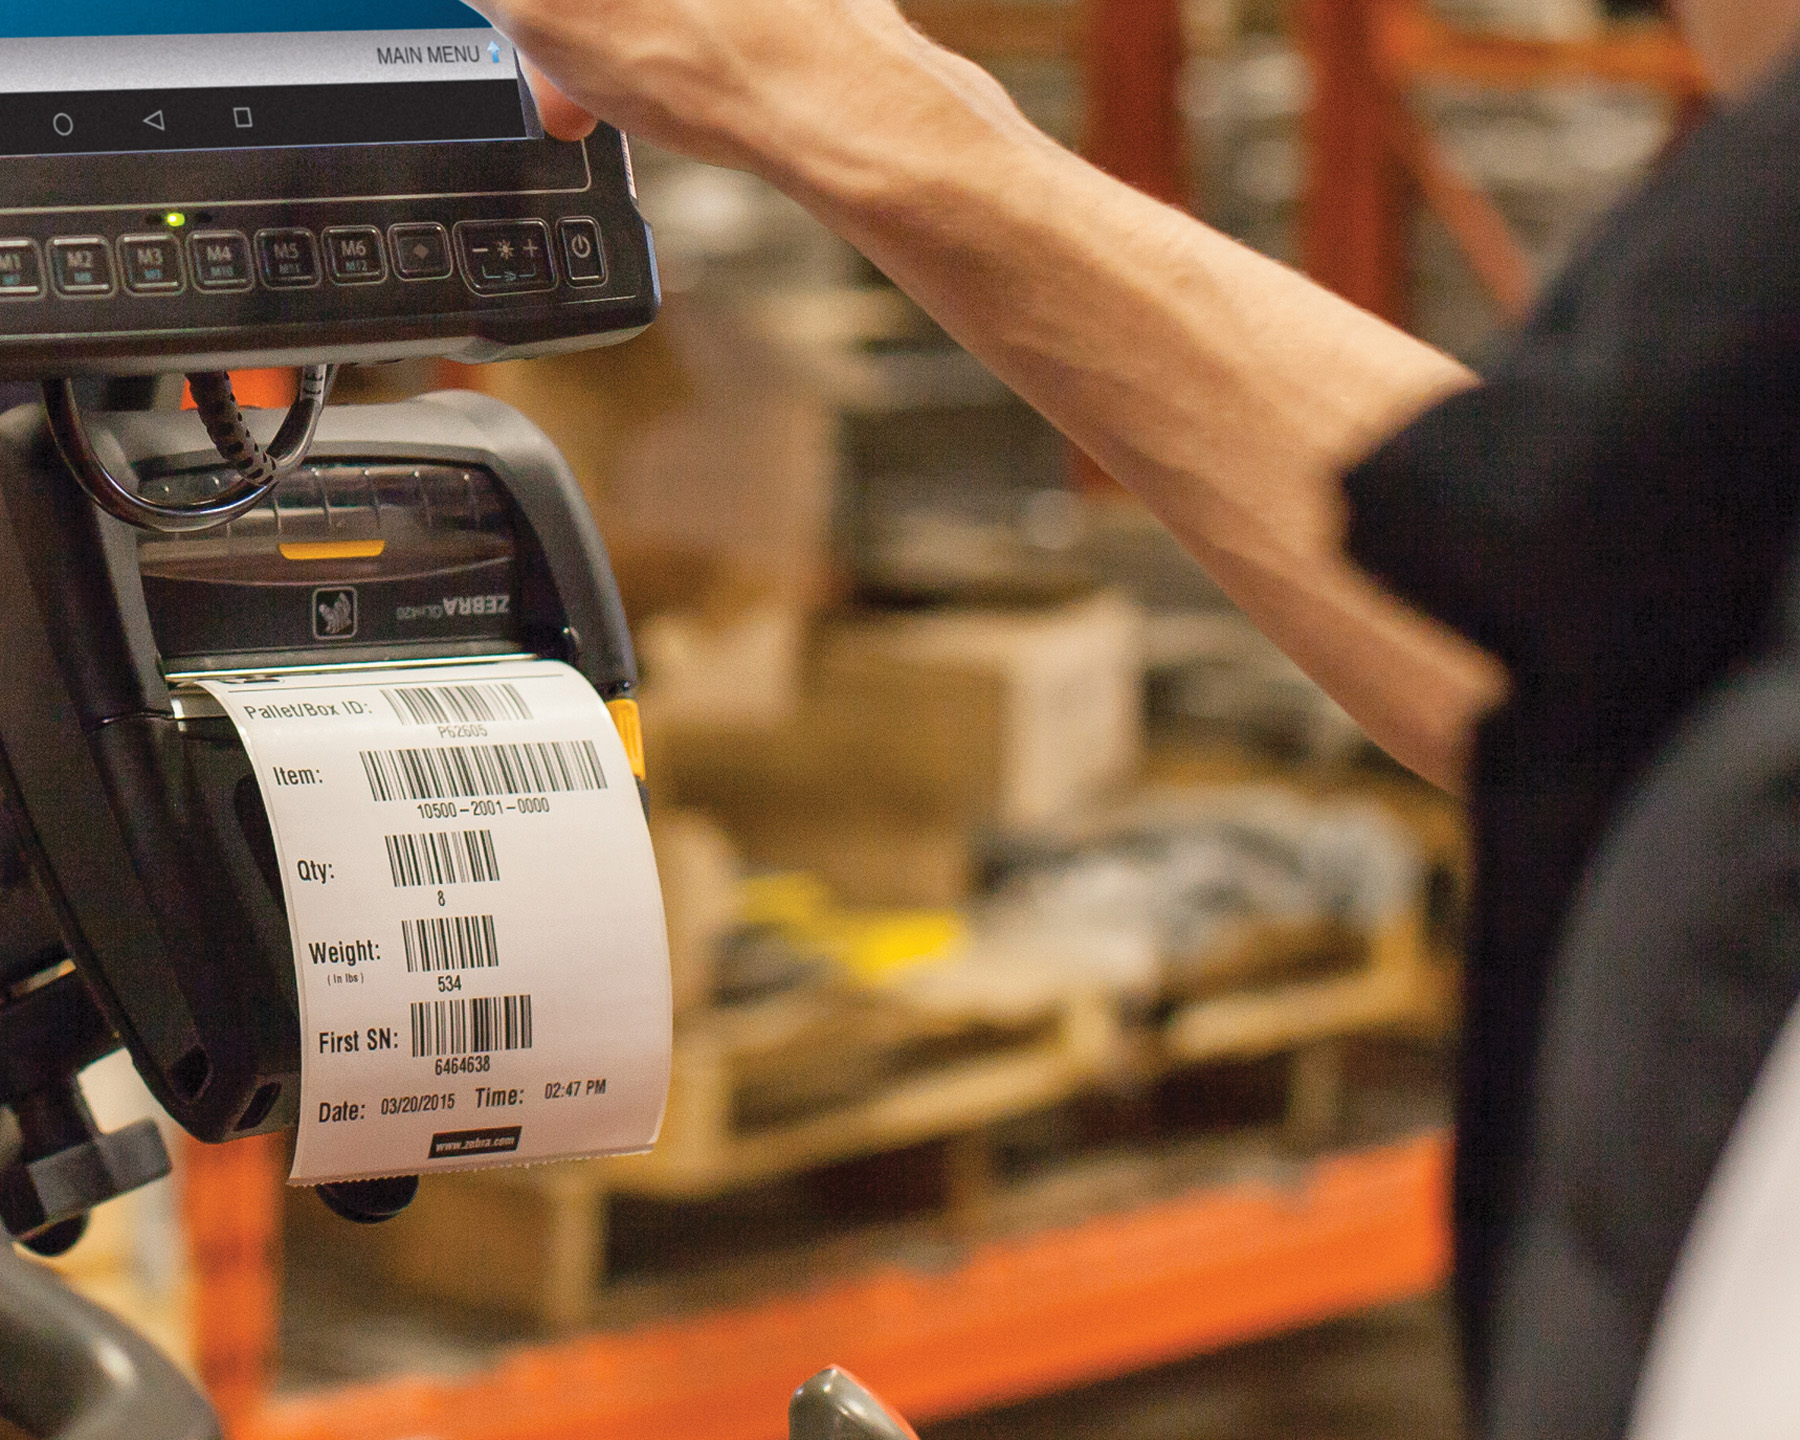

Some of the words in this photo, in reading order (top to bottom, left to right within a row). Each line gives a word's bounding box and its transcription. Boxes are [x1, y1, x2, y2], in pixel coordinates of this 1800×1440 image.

[377, 46, 423, 64] MAIN
[427, 45, 480, 63] MENU
[137, 248, 164, 265] M3
[206, 245, 232, 262] M4
[273, 242, 299, 259] M5
[341, 239, 367, 256] M6
[66, 250, 93, 268] M2
[443, 594, 510, 616] ZEBRA
[243, 702, 340, 720] Pallet/Box
[345, 700, 373, 716] ID:
[437, 724, 488, 739] P62605
[273, 766, 324, 786] Item:
[296, 859, 335, 884] Qty:
[437, 890, 446, 907] 8
[308, 939, 381, 966] Weight:
[437, 975, 462, 993] 534
[319, 1030, 359, 1053] First
[367, 1027, 399, 1050] SN:
[435, 1055, 491, 1076] 6464638
[319, 1101, 365, 1123] Date:
[381, 1092, 455, 1116] 03/20/2015
[475, 1086, 524, 1108] Time:
[544, 1079, 581, 1099] 02:47
[586, 1078, 606, 1095] PM
